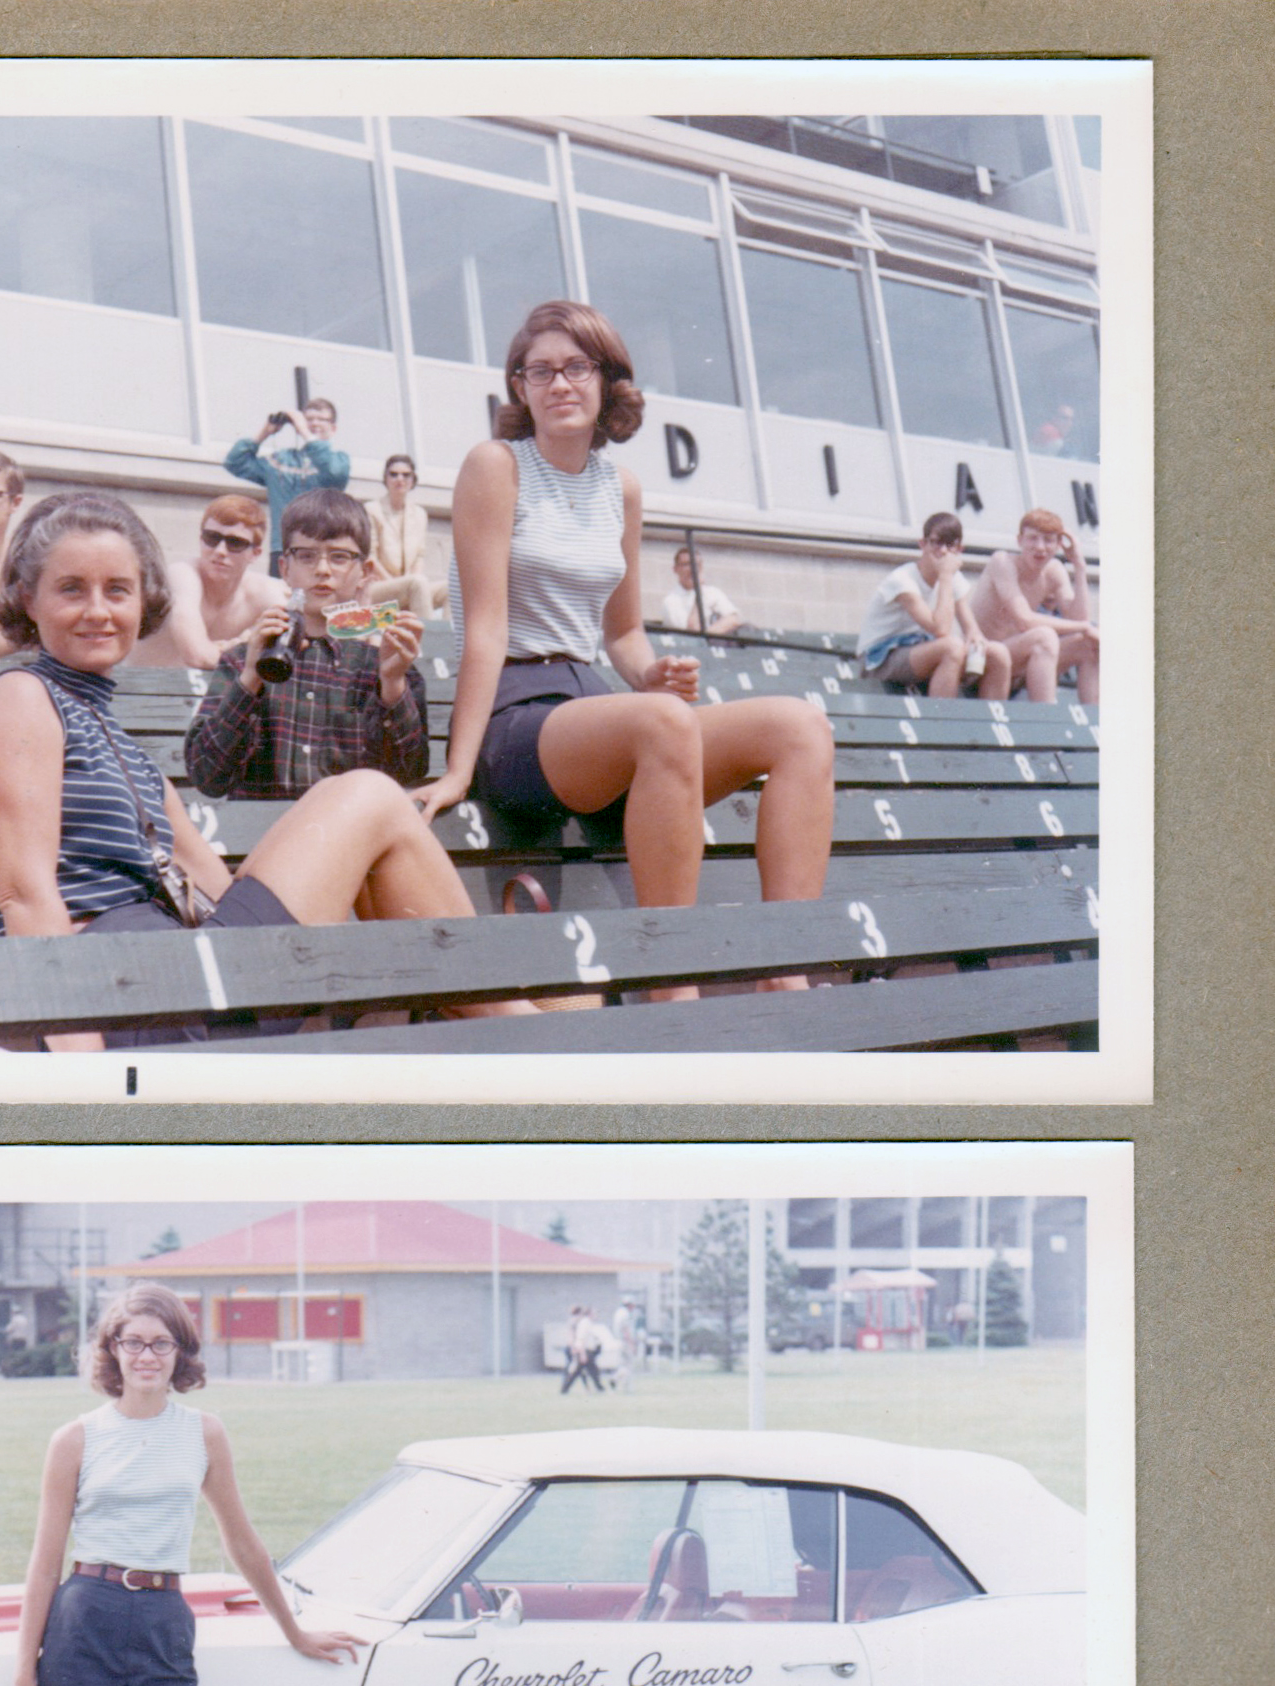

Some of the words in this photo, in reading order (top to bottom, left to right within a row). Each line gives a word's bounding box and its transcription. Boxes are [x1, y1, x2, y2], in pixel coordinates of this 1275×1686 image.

[187, 668, 209, 695] 5
[899, 719, 919, 744] 9
[889, 751, 910, 783] 7
[1015, 753, 1036, 783] 8
[190, 801, 228, 855] 2
[458, 801, 490, 850] 3
[874, 799, 903, 841] 5
[1039, 800, 1064, 837] 6
[564, 914, 610, 983] 2
[848, 901, 888, 958] 3
[195, 932, 227, 1010] 1
